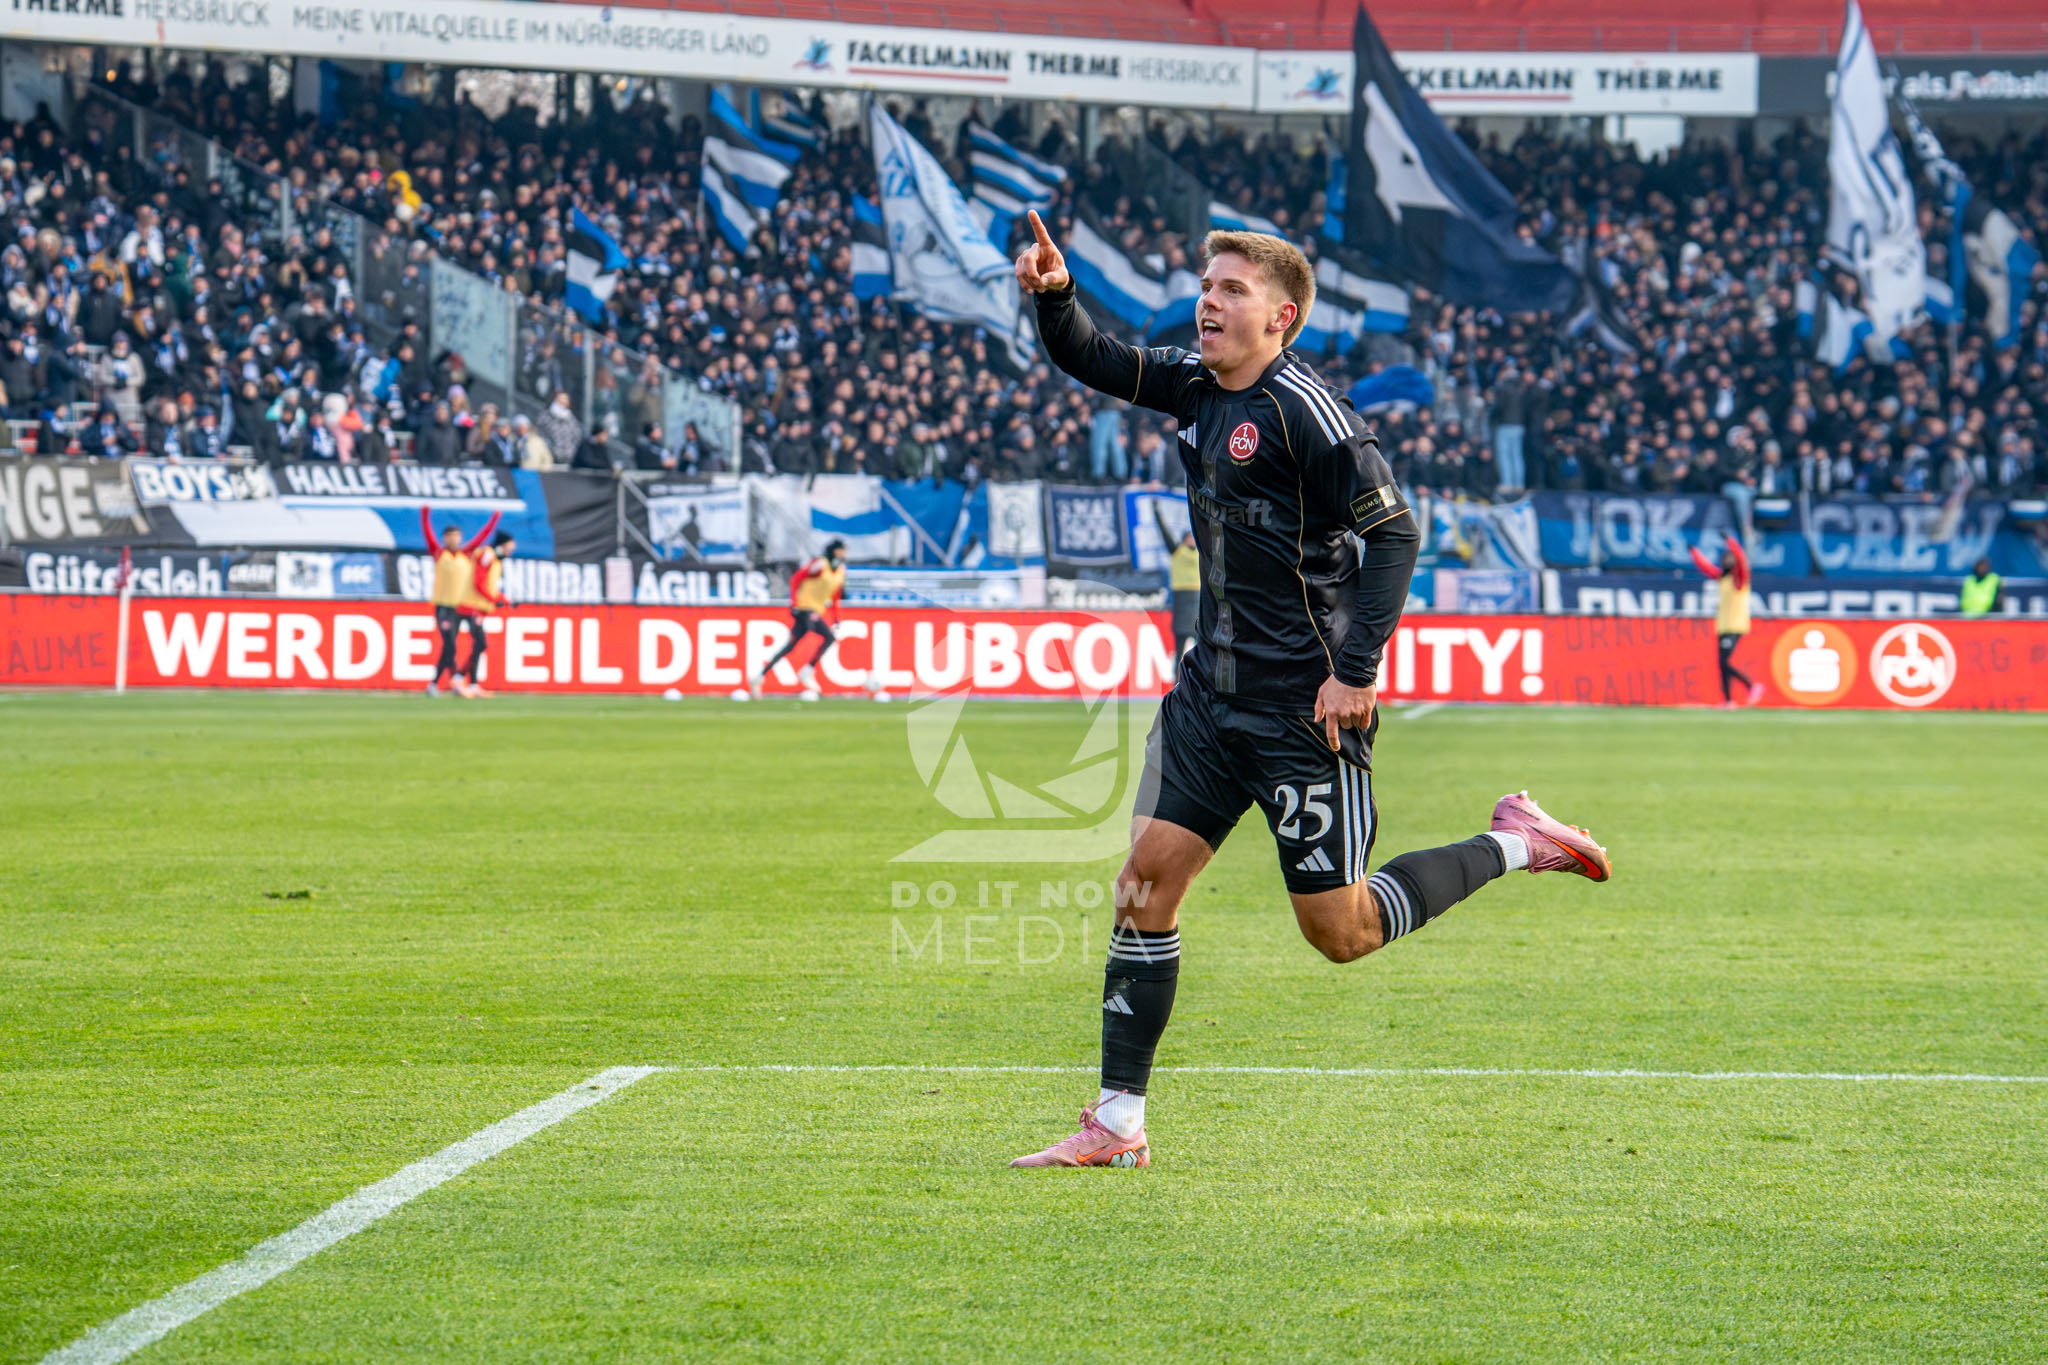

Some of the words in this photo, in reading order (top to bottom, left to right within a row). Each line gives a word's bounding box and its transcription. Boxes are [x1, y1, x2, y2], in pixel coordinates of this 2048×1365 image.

[292, 7, 363, 32] MEINE
[371, 11, 518, 42] VITALQUELLE
[525, 22, 549, 42] IM
[847, 41, 1010, 72] FACKELMANN
[1027, 52, 1121, 78] THERME
[1129, 57, 1242, 86] HERSBRUCK
[1596, 67, 1723, 90] THERME
[1232, 436, 1254, 450] FCN
[133, 464, 233, 502] BOYS
[285, 465, 384, 495] HALLE
[1811, 504, 2005, 571] CREW
[142, 610, 436, 680] WERDE
[639, 619, 798, 686] DER
[1275, 783, 1333, 840] 25
